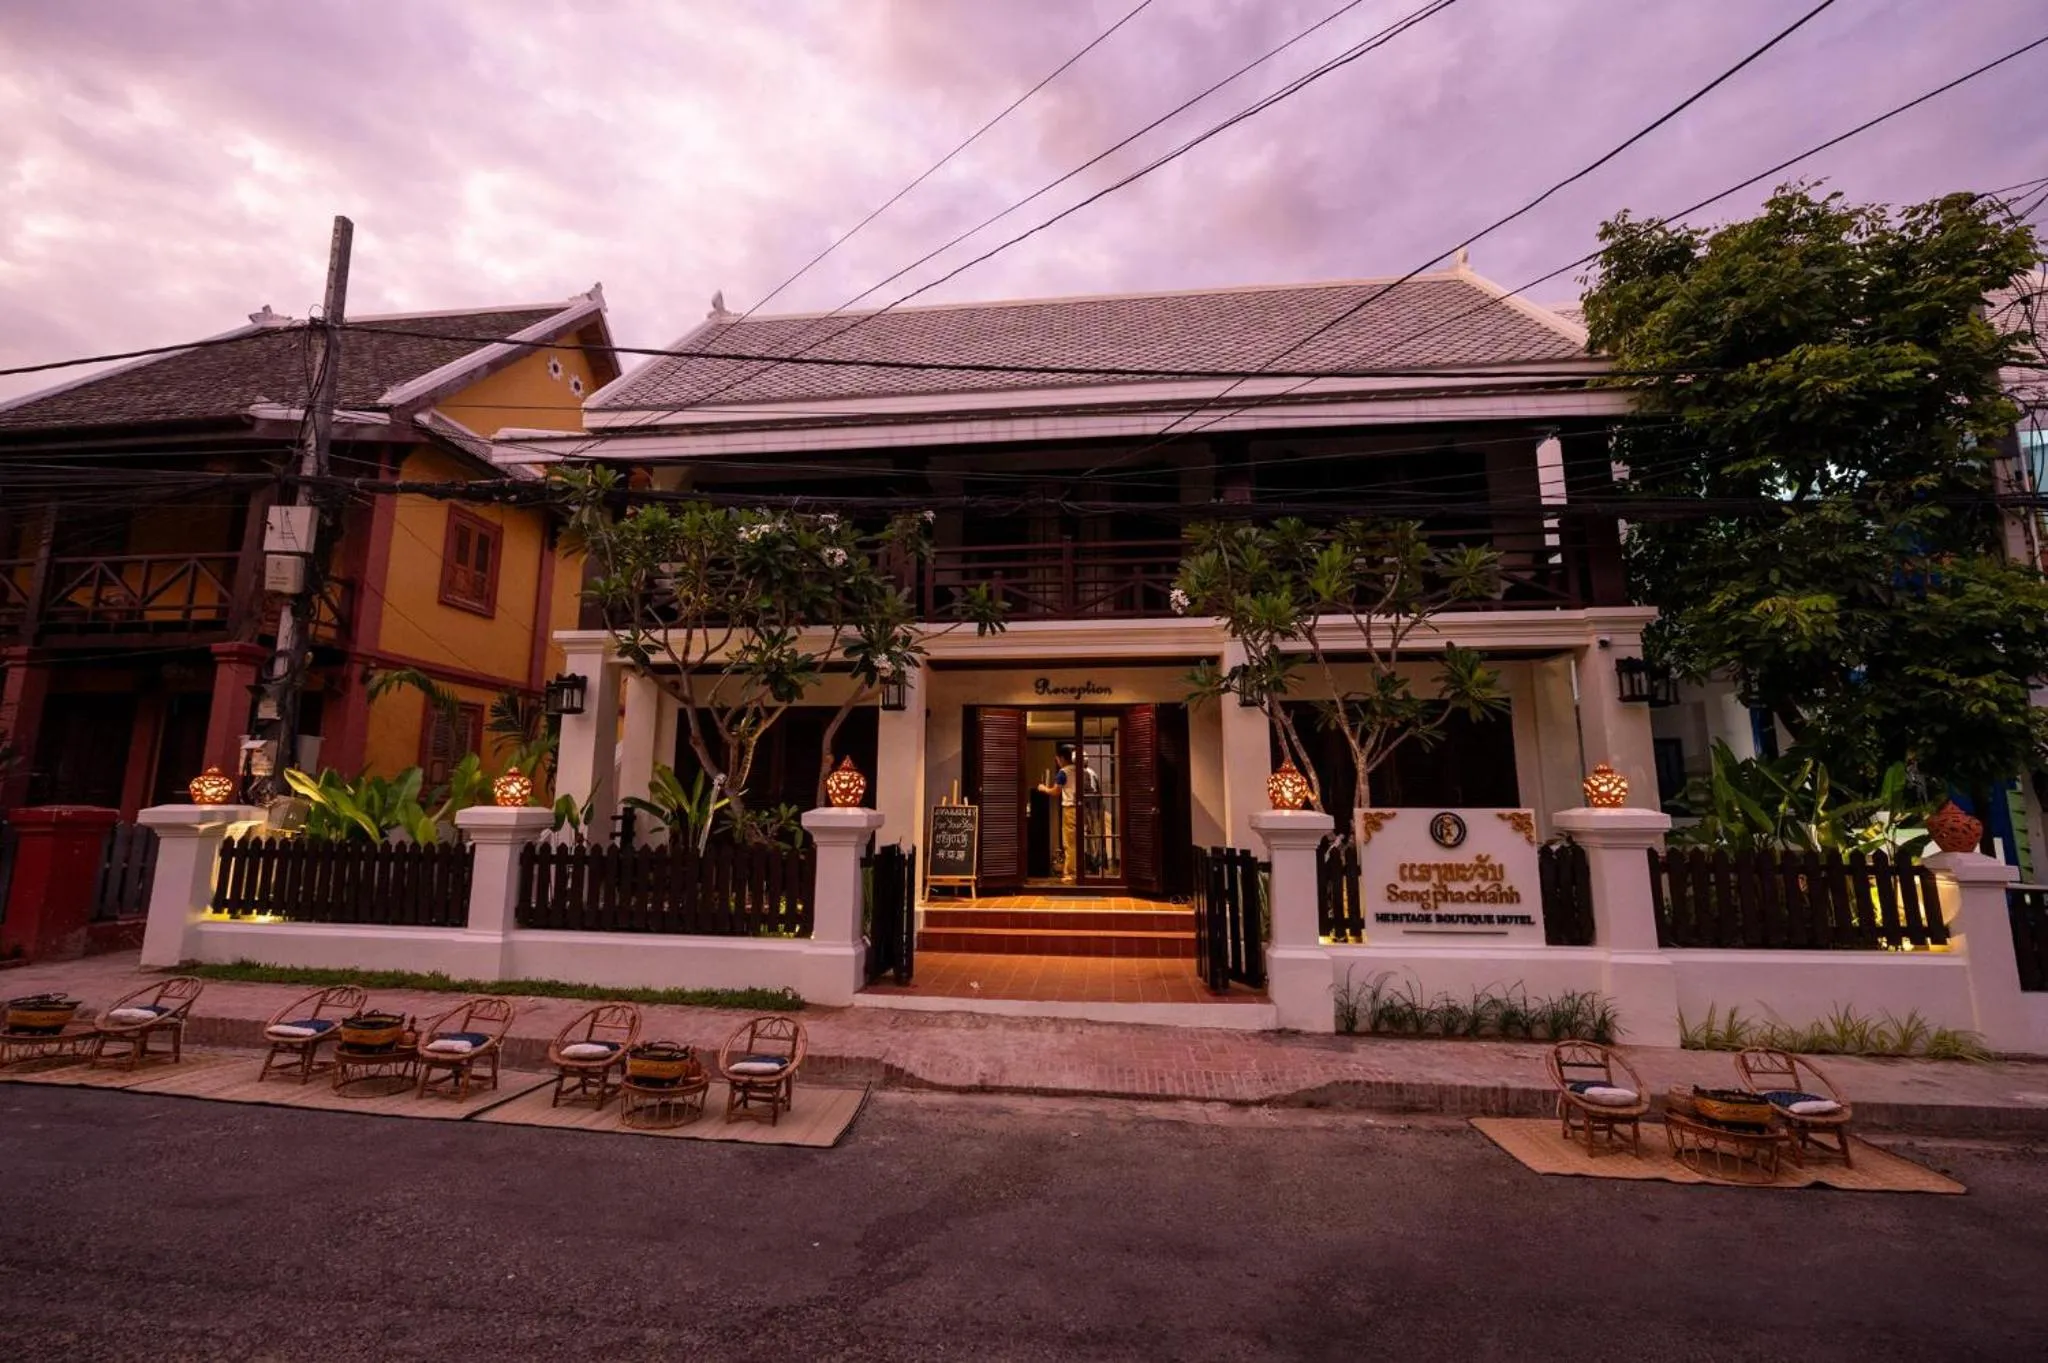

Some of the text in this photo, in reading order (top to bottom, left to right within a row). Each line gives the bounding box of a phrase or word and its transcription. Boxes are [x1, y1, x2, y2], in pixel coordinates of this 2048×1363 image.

[1034, 678, 1112, 699] Reception
[1375, 913, 1536, 926] HERITAGE BOUTIQUE HOTEL
